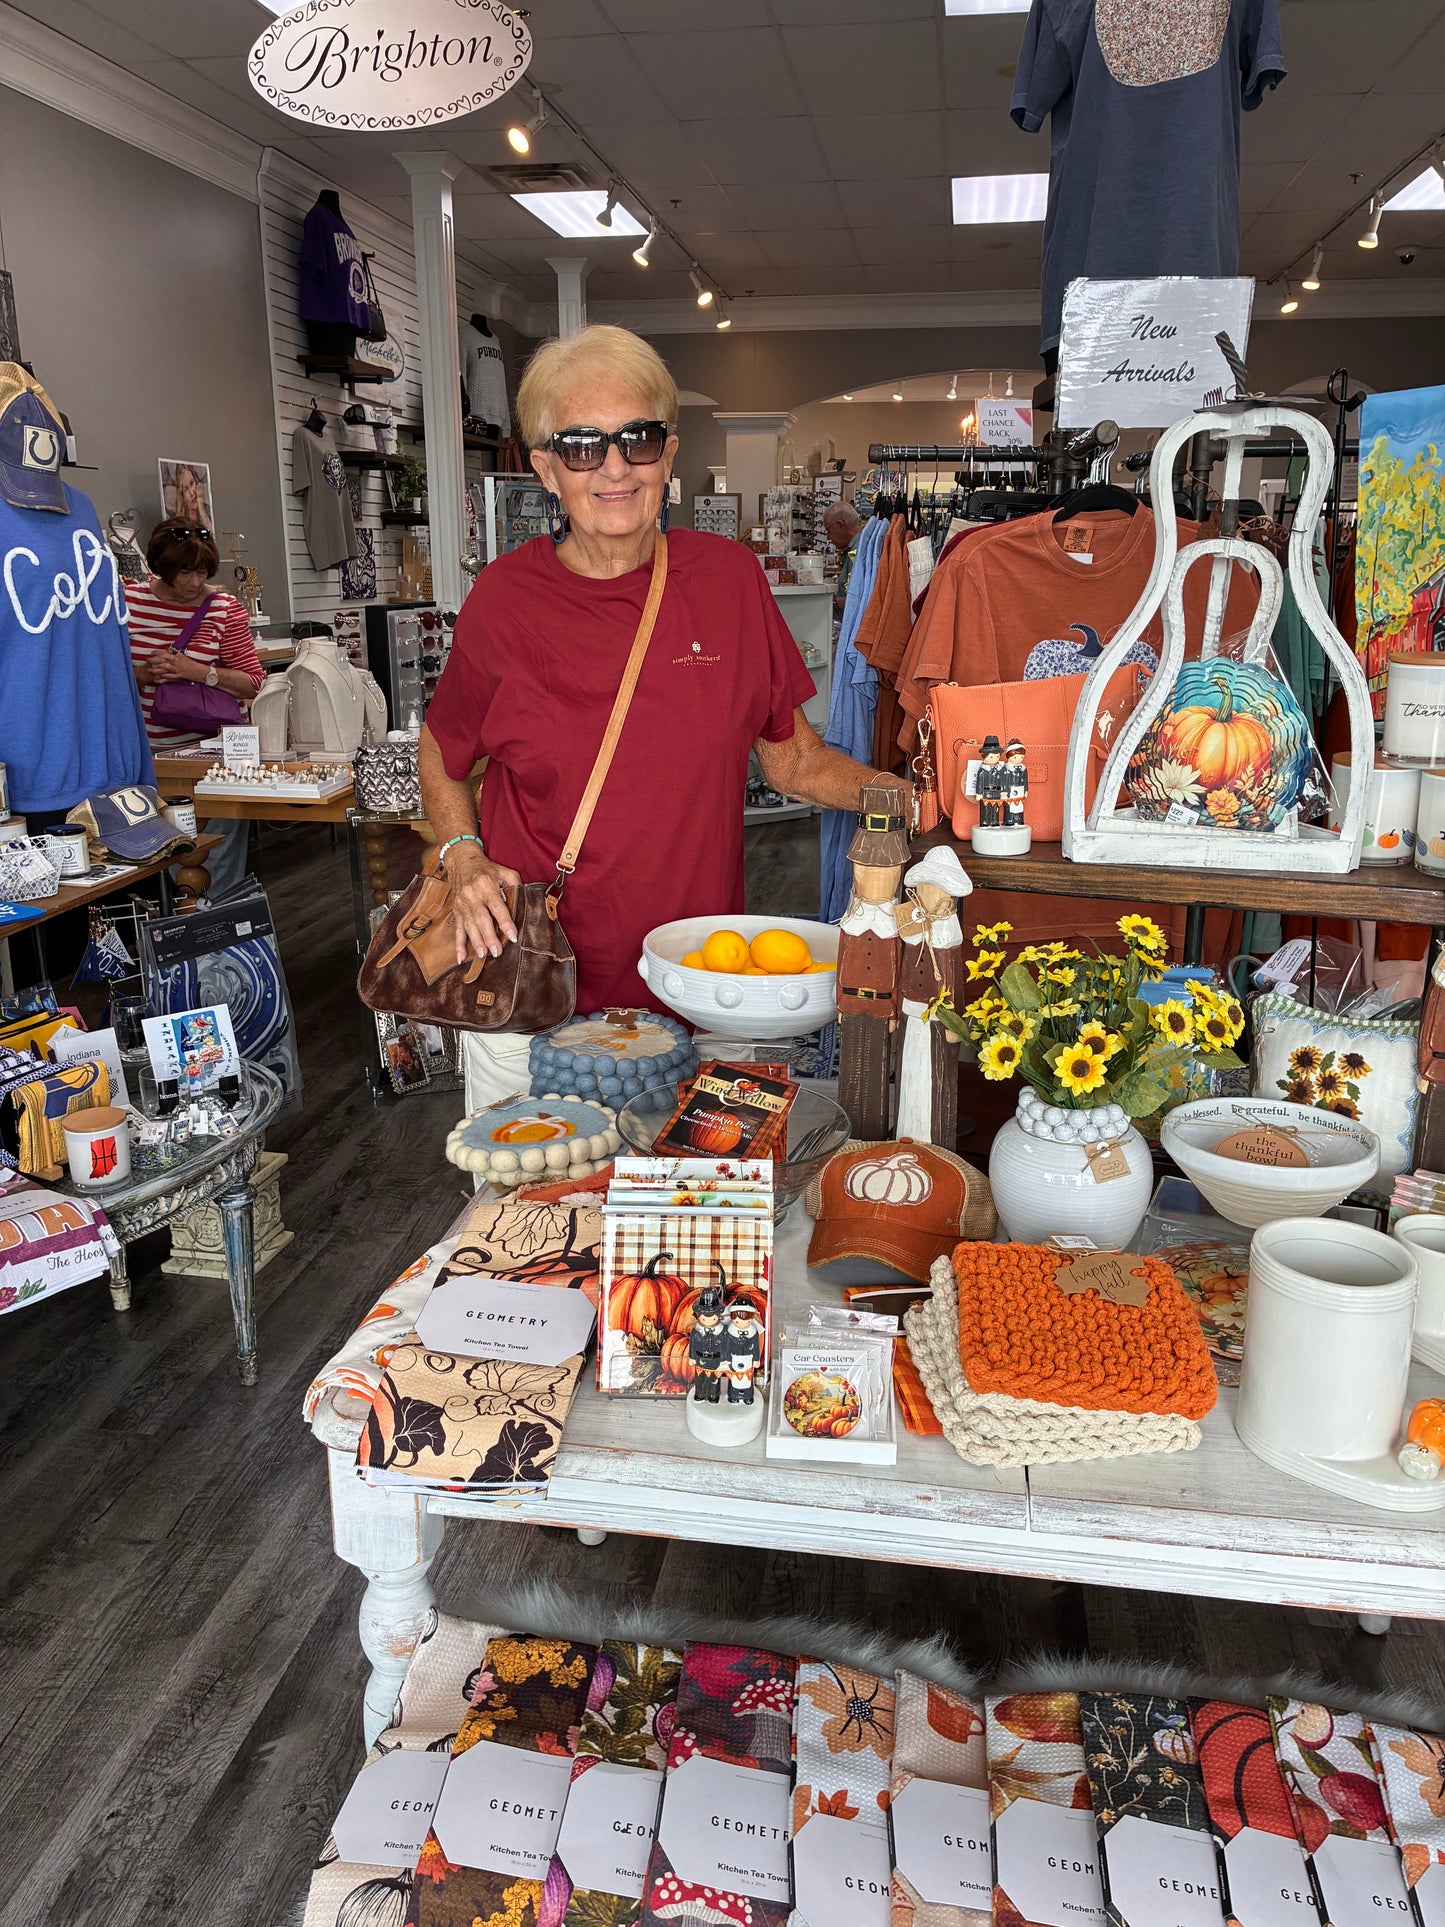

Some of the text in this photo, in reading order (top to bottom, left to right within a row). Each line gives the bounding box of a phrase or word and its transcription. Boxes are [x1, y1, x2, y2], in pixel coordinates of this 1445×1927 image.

[281, 24, 493, 93] Brighton
[1131, 314, 1177, 340] New
[478, 346, 503, 360] PURDU
[1101, 358, 1196, 383] Arrivals
[989, 409, 1007, 417] LAST
[982, 419, 1015, 427] CHANCE
[4, 529, 130, 634] Colt
[67, 1049, 101, 1061] Indiana
[699, 1077, 733, 1097] Wind
[692, 1108, 751, 1130] Pumpkin Pie
[1192, 1106, 1222, 1119] blessed.
[1245, 1107, 1290, 1117] grateful.
[1298, 1111, 1310, 1122] be
[1256, 1136, 1277, 1147] the
[1235, 1141, 1294, 1161] thankful
[1246, 1153, 1278, 1166] bowl
[46, 1245, 105, 1271] The Hoos
[1069, 1259, 1122, 1284] happy
[1099, 1270, 1131, 1300] fall
[466, 1310, 549, 1327] GEOMETRY
[463, 1338, 492, 1346] Kitchen
[507, 1343, 529, 1351] Towel
[793, 1353, 855, 1363] Car Coasters
[489, 1799, 558, 1822] GEOMET
[711, 1815, 790, 1842] GEOMETR
[384, 1841, 414, 1851] Kitchen
[489, 1844, 521, 1857] Kitchen
[522, 1851, 537, 1860] Tea
[943, 1835, 989, 1853] GEOM
[717, 1862, 789, 1883] Kitchen Tea Towe
[1047, 1856, 1094, 1875] GEOM
[845, 1876, 890, 1897] GEOM
[959, 1880, 991, 1892] Kitchen
[1159, 1877, 1219, 1900] GEOME
[1280, 1888, 1316, 1906] GEO
[1372, 1895, 1408, 1912] GEO
[1062, 1901, 1095, 1914] Kitchen
